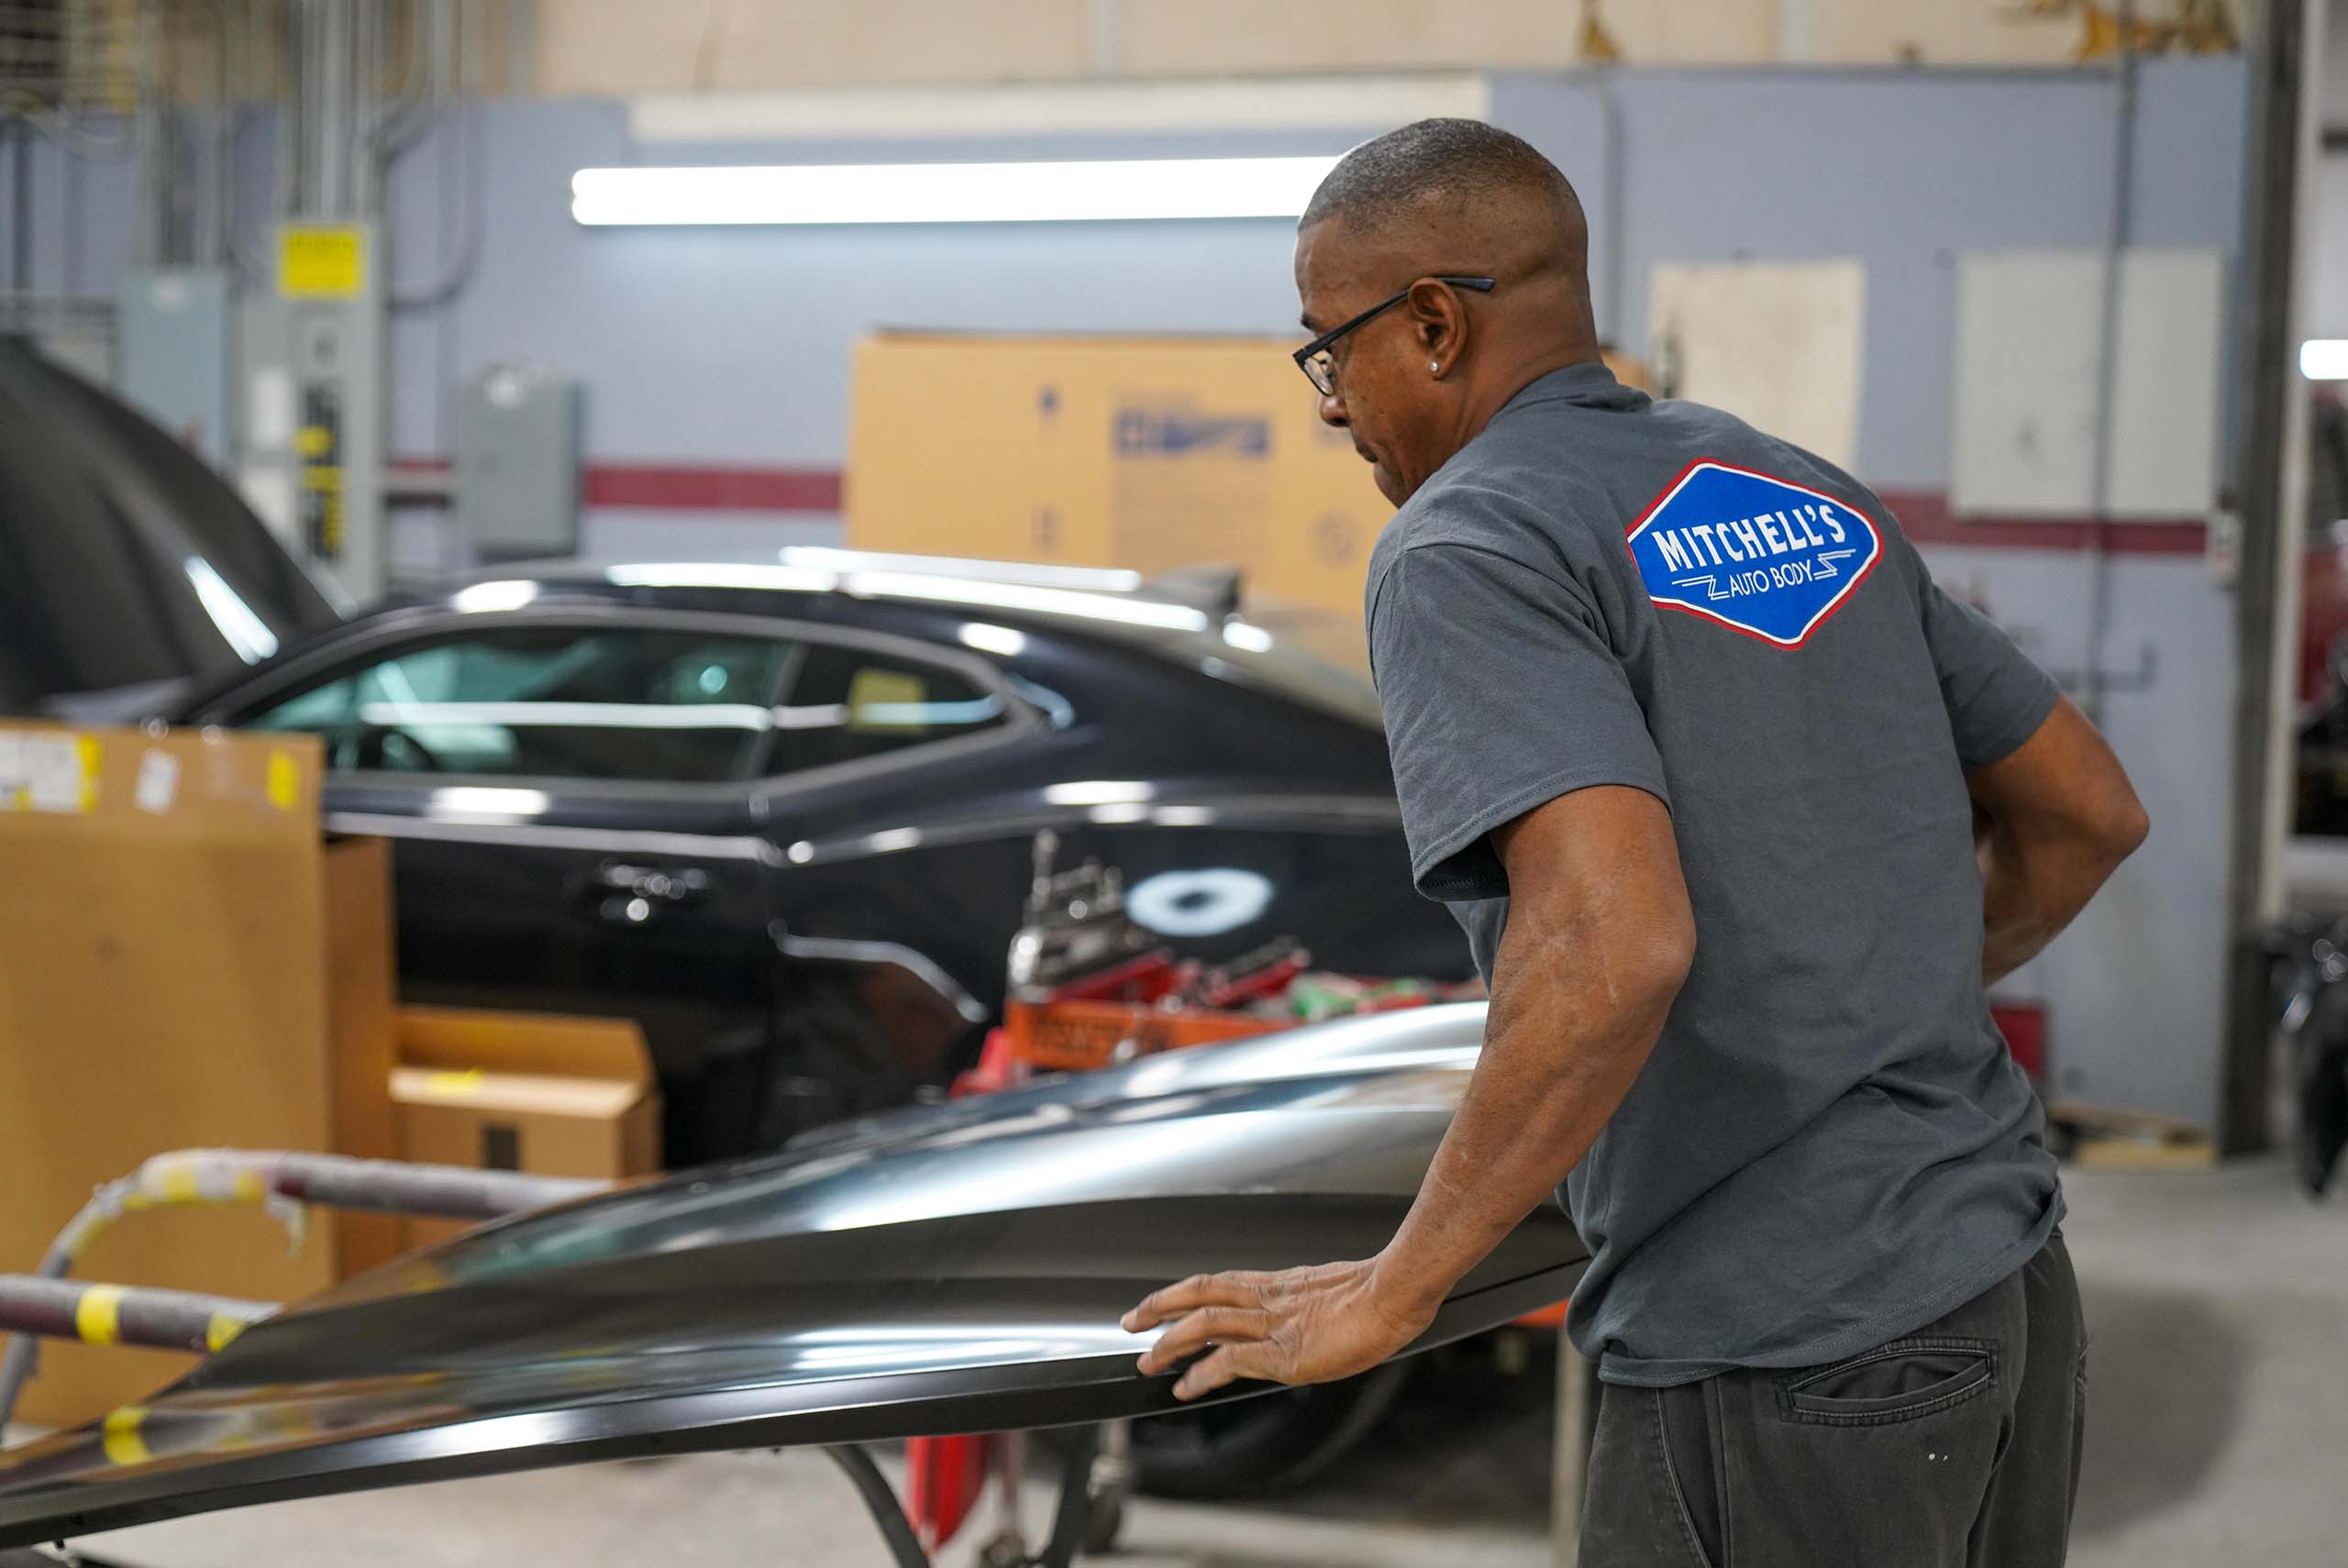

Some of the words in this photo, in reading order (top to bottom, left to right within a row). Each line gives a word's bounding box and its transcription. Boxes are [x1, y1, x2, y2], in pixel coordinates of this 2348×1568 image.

[1651, 504, 1846, 572] MITCHELL'S
[1729, 570, 1769, 598] AUTO
[1769, 559, 1814, 588] BODY
